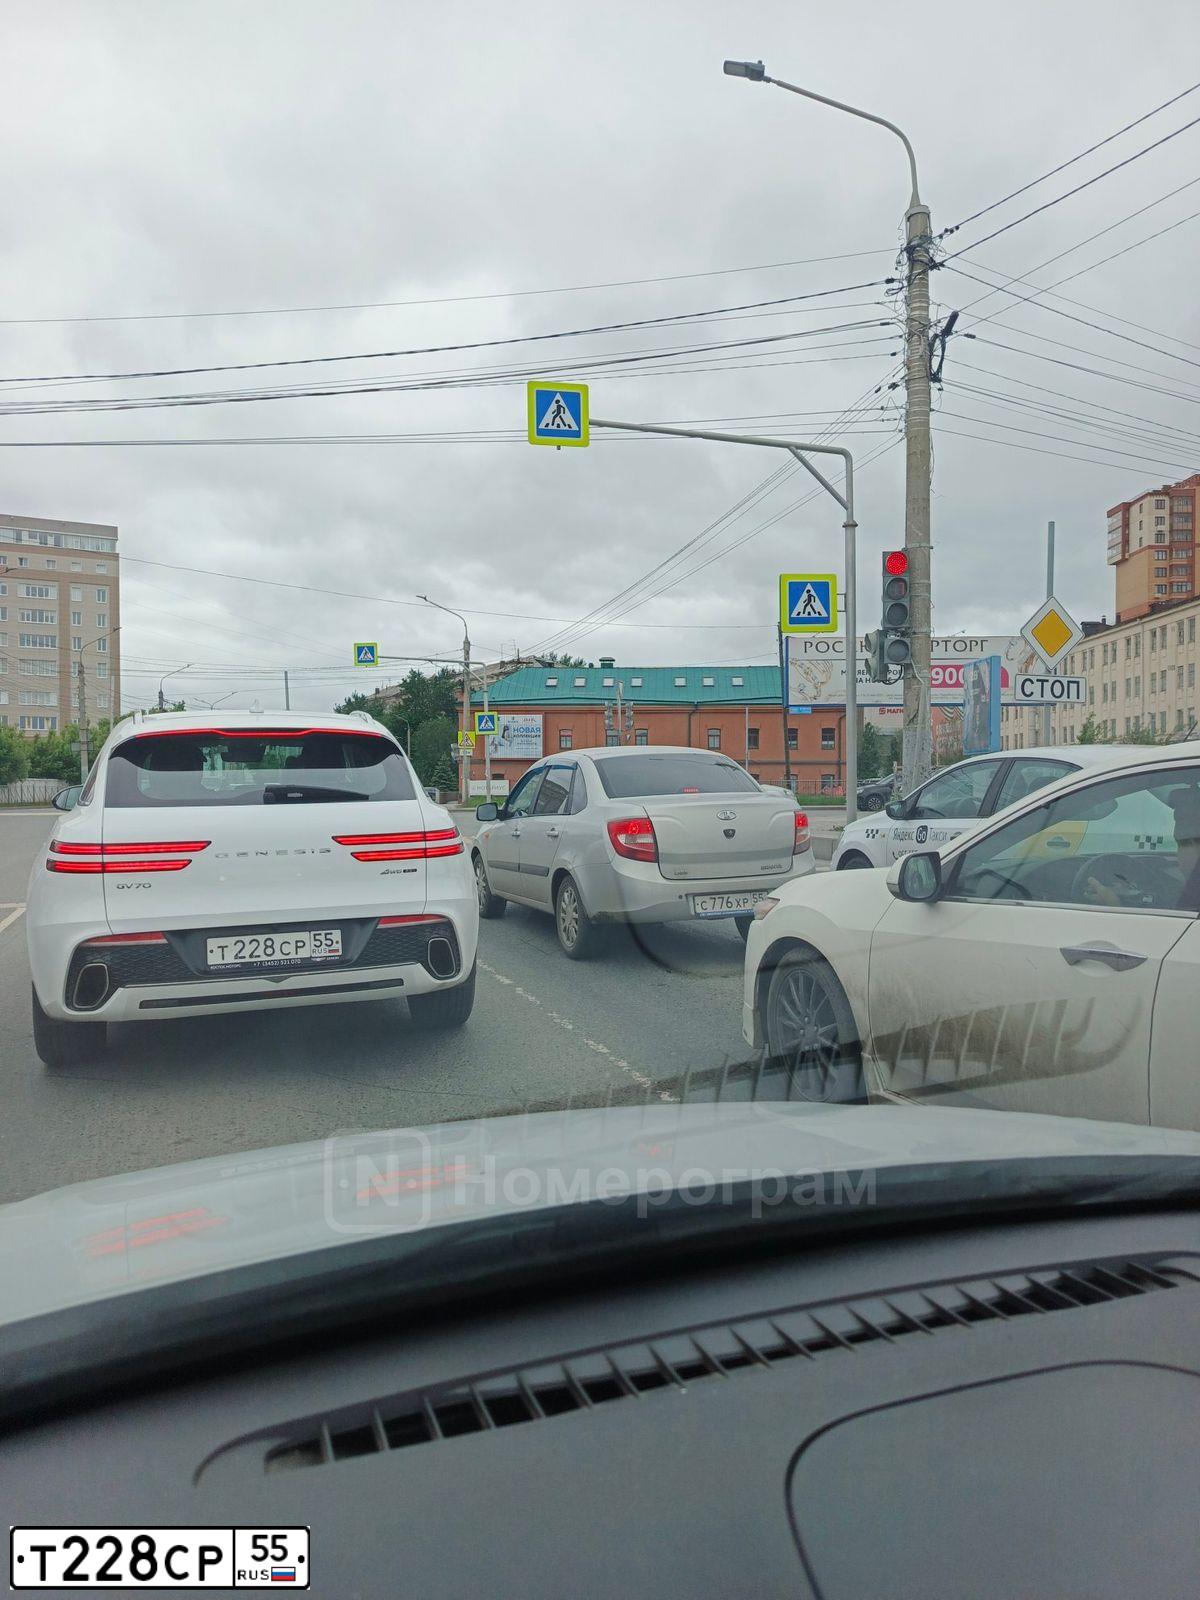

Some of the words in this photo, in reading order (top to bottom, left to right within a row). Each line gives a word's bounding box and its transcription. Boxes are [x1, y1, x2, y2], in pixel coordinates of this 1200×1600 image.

[1020, 677, 1080, 700] СТОП
[512, 726, 541, 734] НОВАЯ
[214, 848, 332, 858] GENESIS
[116, 882, 152, 890] GV70
[700, 896, 749, 911] С776ХР
[217, 937, 306, 961] Т228СР
[313, 932, 334, 948] 55
